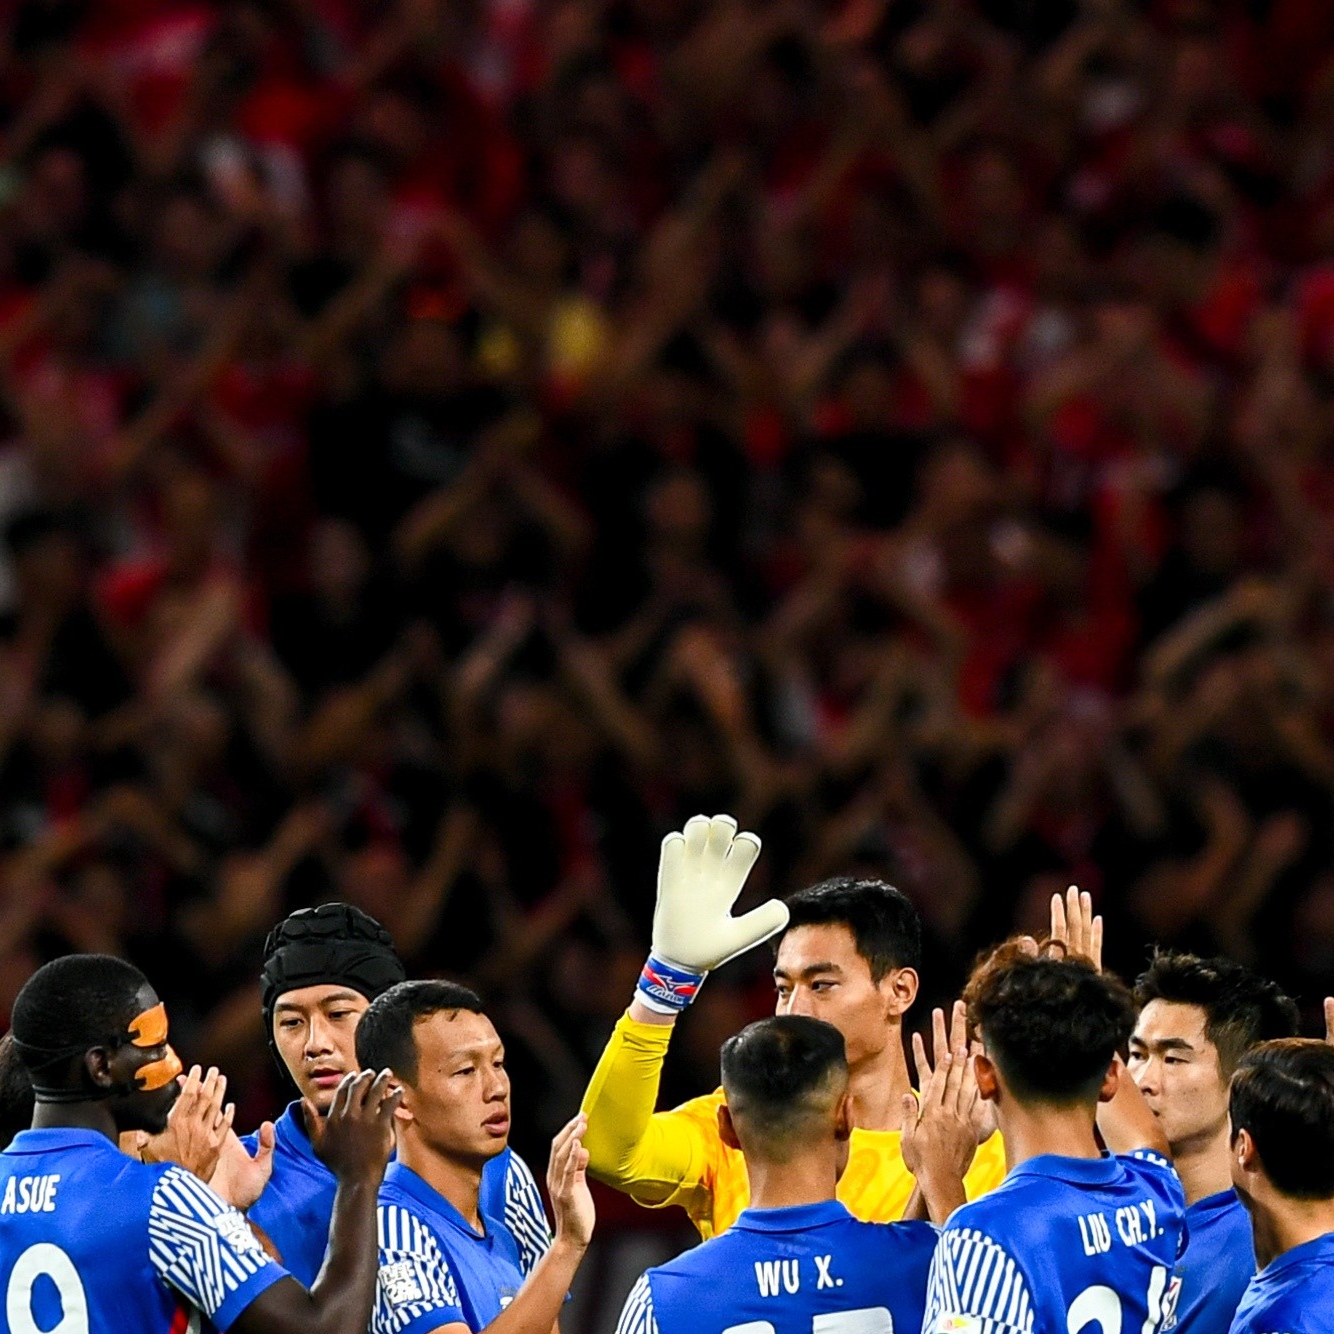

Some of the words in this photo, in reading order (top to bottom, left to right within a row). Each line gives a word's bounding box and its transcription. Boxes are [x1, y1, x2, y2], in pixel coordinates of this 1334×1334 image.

[0, 1173, 61, 1215] ASUE
[1077, 1212, 1111, 1256] LIU
[1115, 1199, 1164, 1247] CH.Y.
[754, 1259, 800, 1297] WU
[814, 1254, 843, 1290] X.
